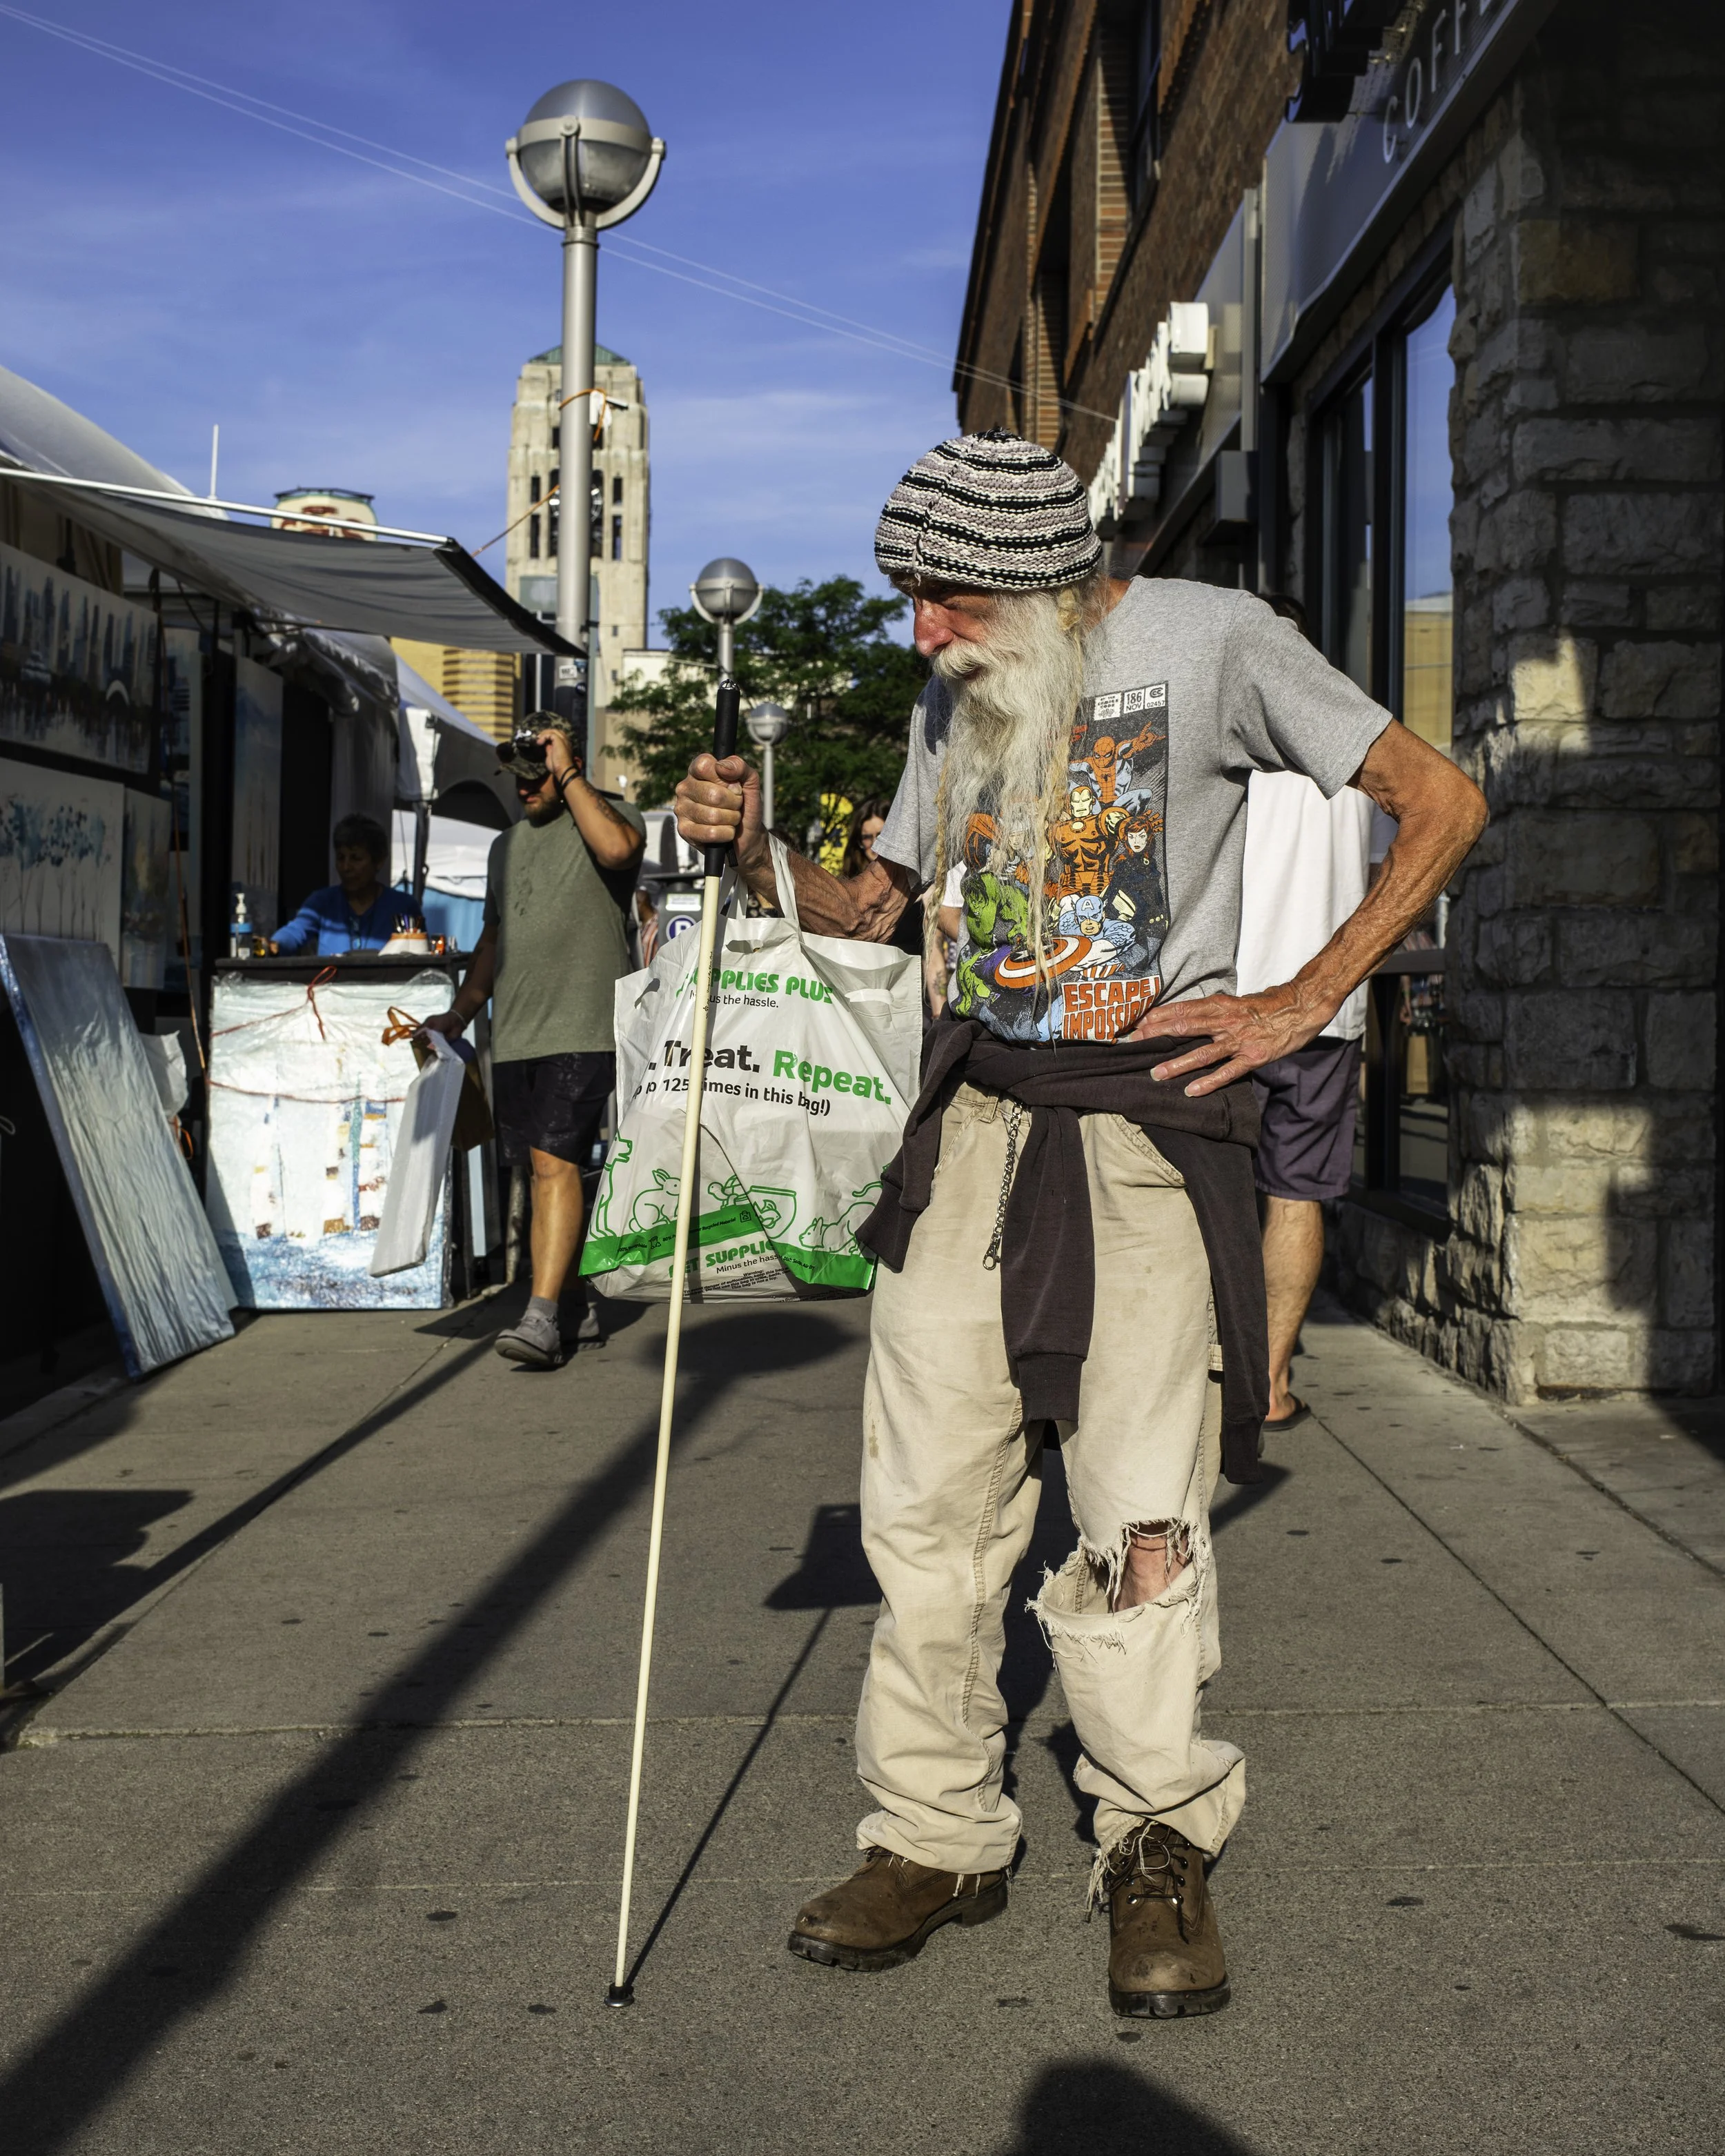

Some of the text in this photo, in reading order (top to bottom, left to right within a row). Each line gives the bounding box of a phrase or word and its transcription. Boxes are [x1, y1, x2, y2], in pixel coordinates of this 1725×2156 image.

[1383, 0, 1490, 163] COFF
[1126, 692, 1142, 704] 186
[1126, 702, 1142, 711] NOV
[723, 994, 741, 1005] the
[744, 994, 778, 1008] hassle.
[1063, 978, 1151, 1013] ESCAPE
[773, 1049, 891, 1105] Repeat.
[663, 1077, 689, 1092] 125
[745, 1082, 759, 1099] in
[763, 1087, 793, 1104] this
[716, 1263, 742, 1274] Minus
[743, 1257, 758, 1267] the
